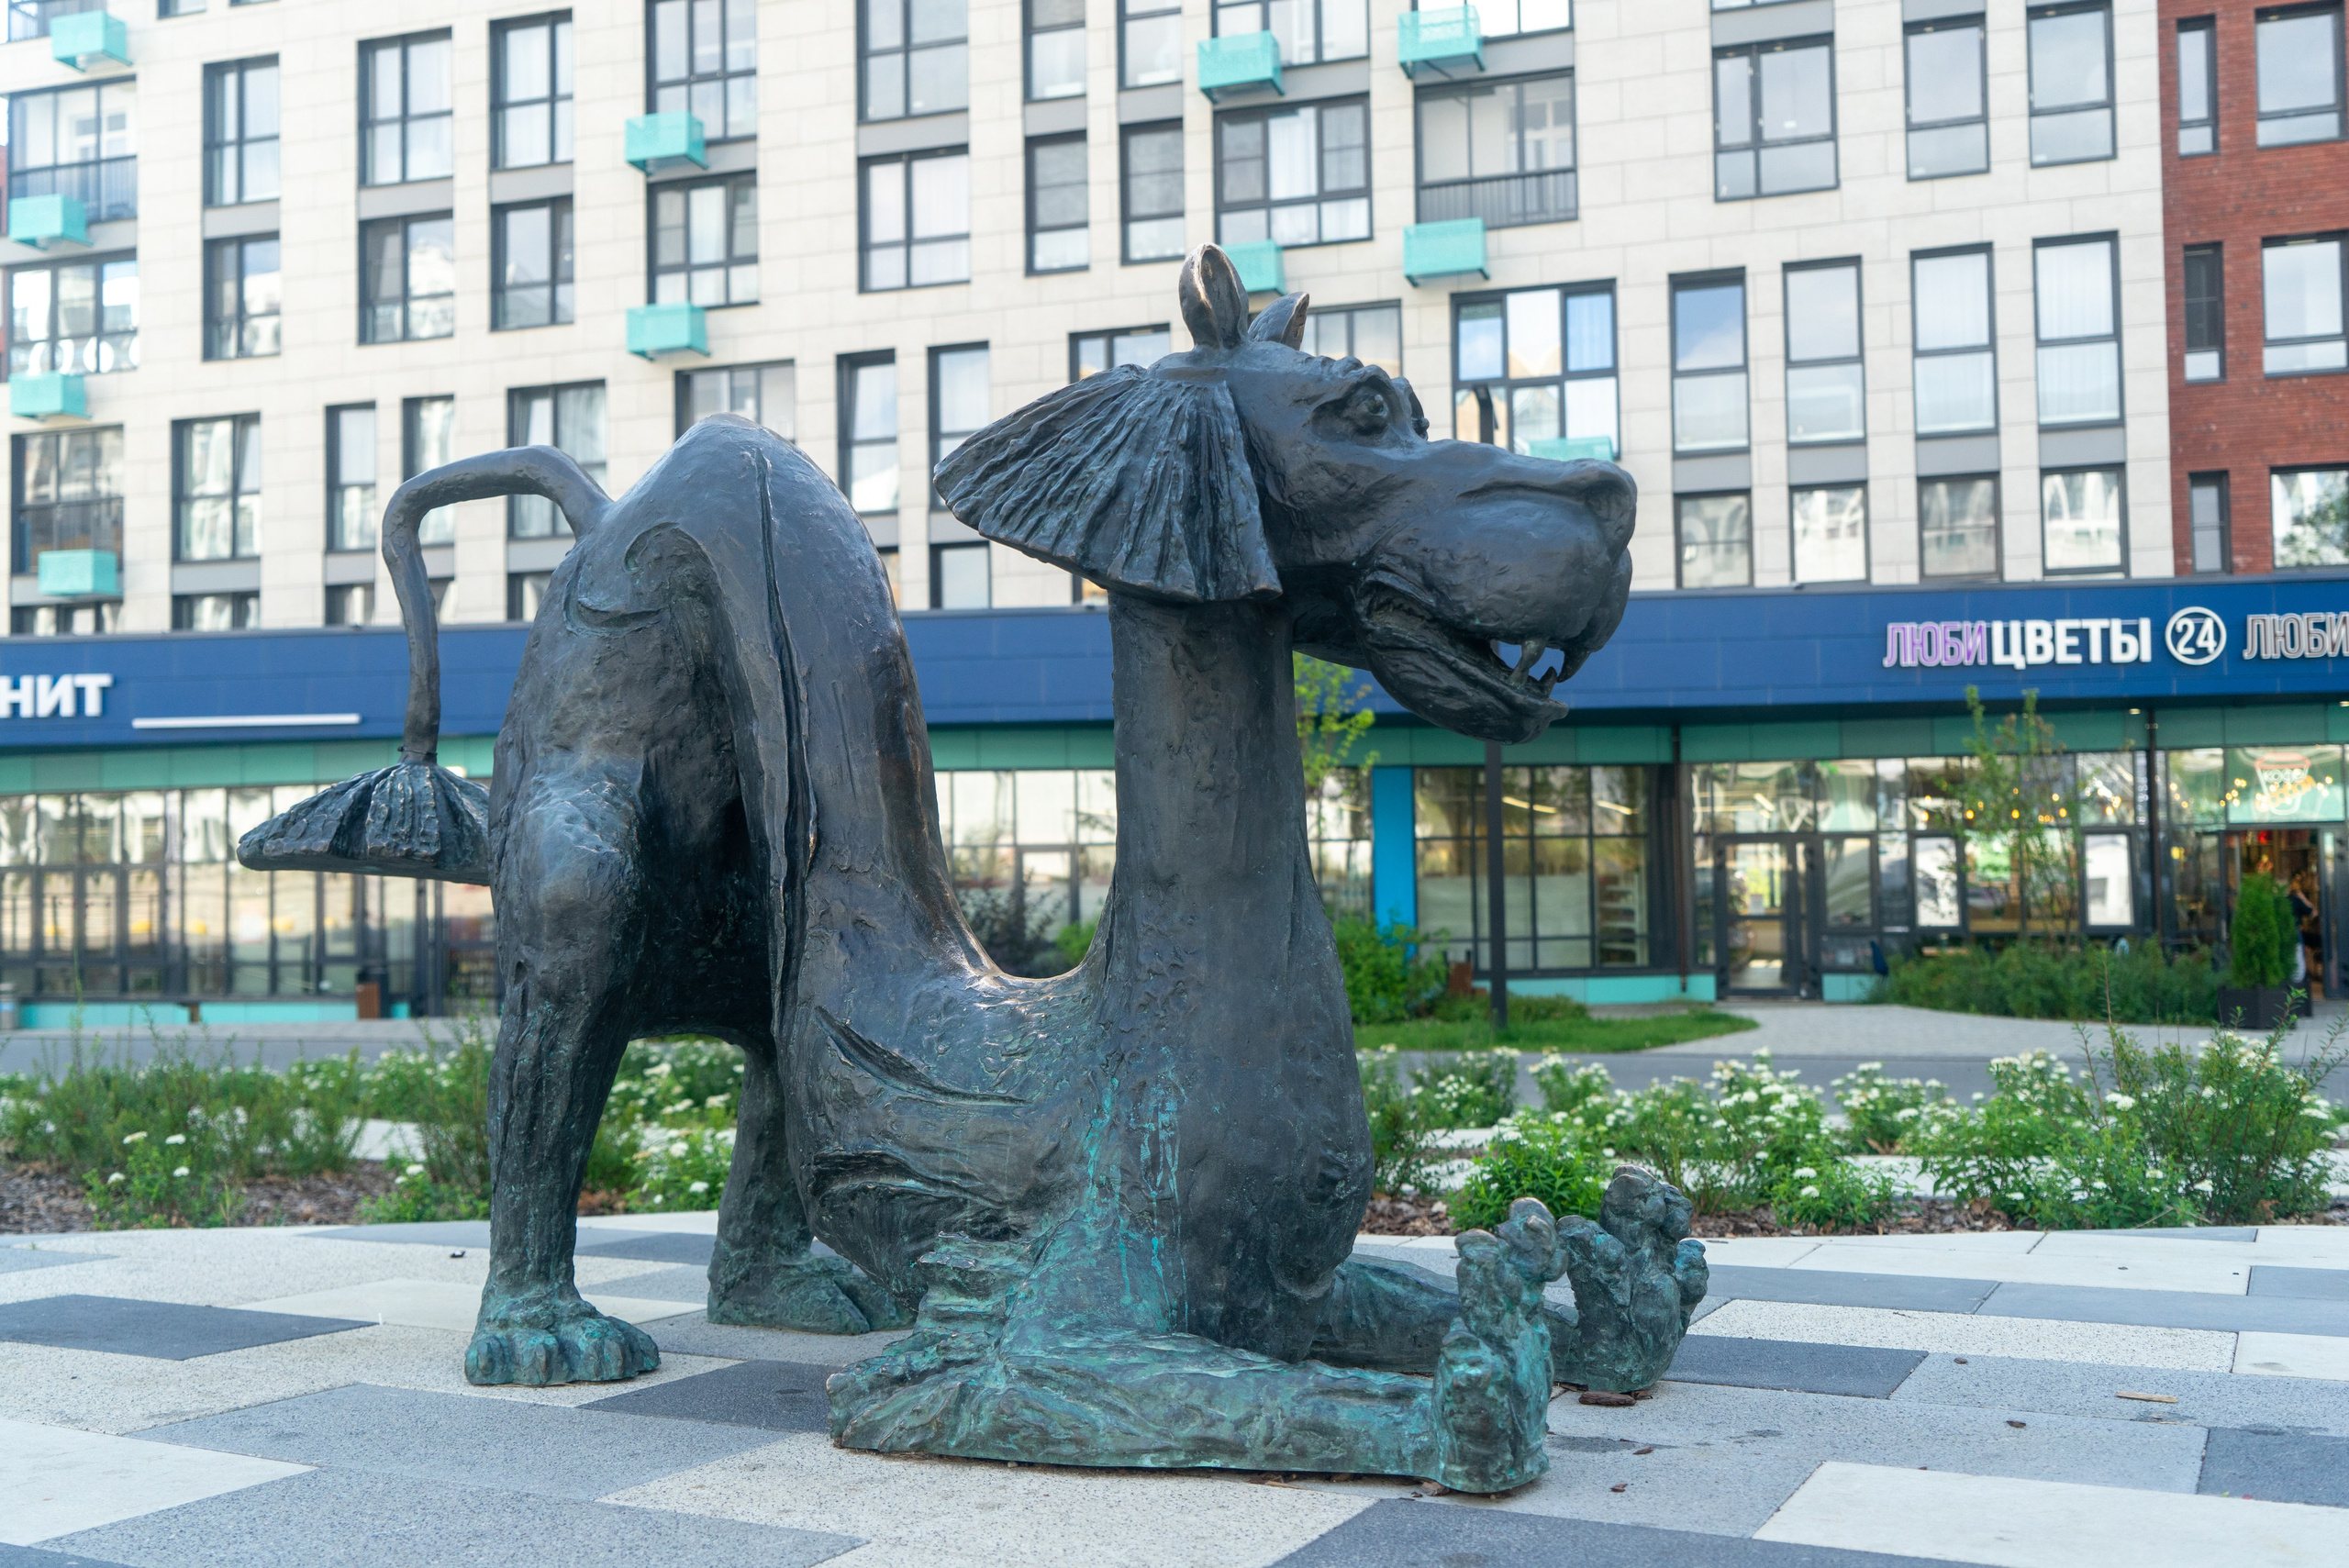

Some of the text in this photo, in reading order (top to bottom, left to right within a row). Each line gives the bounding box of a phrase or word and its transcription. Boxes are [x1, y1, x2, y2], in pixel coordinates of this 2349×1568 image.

[2176, 617, 2217, 654] 24
[2243, 611, 2349, 660] ЛЮБИ
[0, 673, 112, 718] НИТ
